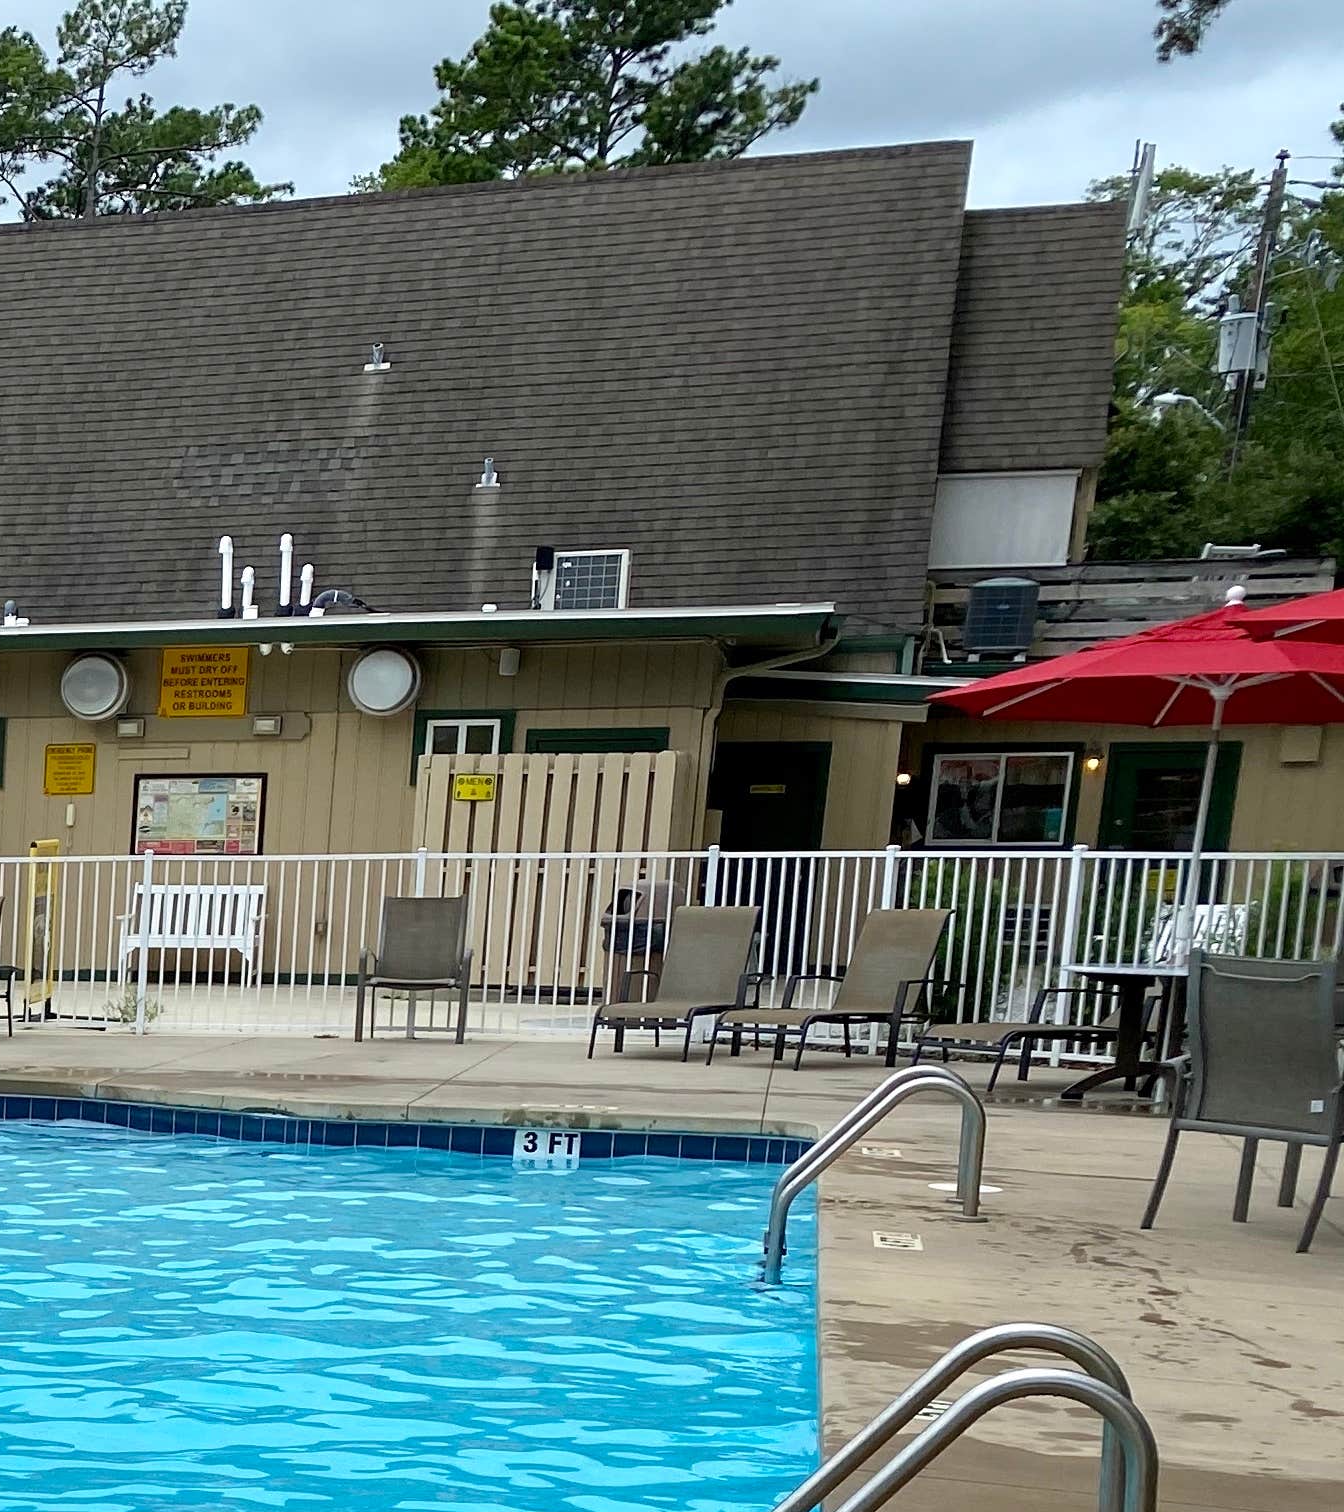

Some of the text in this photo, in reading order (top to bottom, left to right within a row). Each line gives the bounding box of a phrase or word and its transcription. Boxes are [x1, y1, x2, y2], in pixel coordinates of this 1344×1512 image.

[180, 653, 231, 663] SWIMMERS
[170, 665, 239, 675] MUST DRY OFF
[163, 677, 245, 687] BEFORE ENTERING
[174, 690, 232, 699] RESTROOMS
[172, 701, 233, 711] OR BUILDING
[523, 1131, 579, 1155] 3 FT
